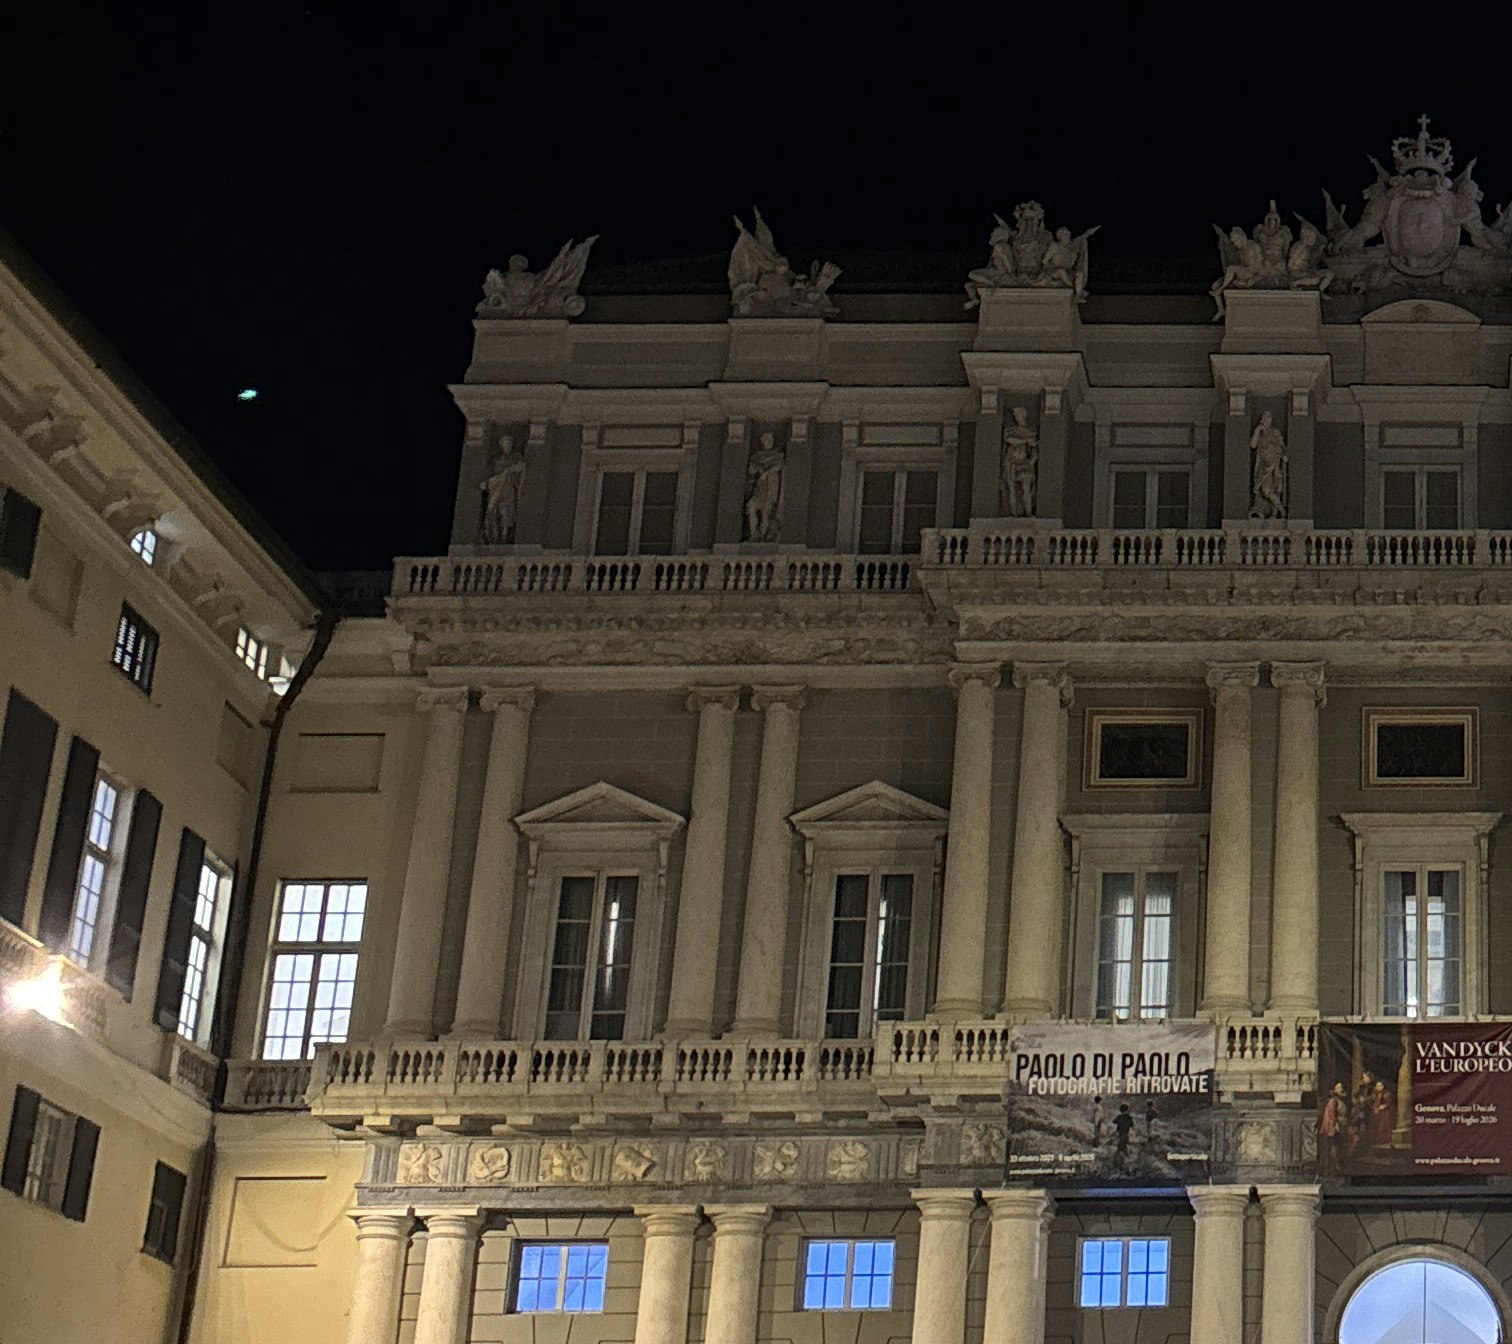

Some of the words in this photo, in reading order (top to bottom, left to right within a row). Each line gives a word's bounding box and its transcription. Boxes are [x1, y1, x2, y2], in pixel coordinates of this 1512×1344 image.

[1016, 1053, 1086, 1081] PAOLO
[1093, 1053, 1113, 1080] DI
[1121, 1051, 1190, 1079] PAOLO
[1416, 1058, 1512, 1073] L'EUROPEO
[1028, 1076, 1121, 1095] FOTOGRAFIE
[1126, 1075, 1209, 1094] RITROVATE
